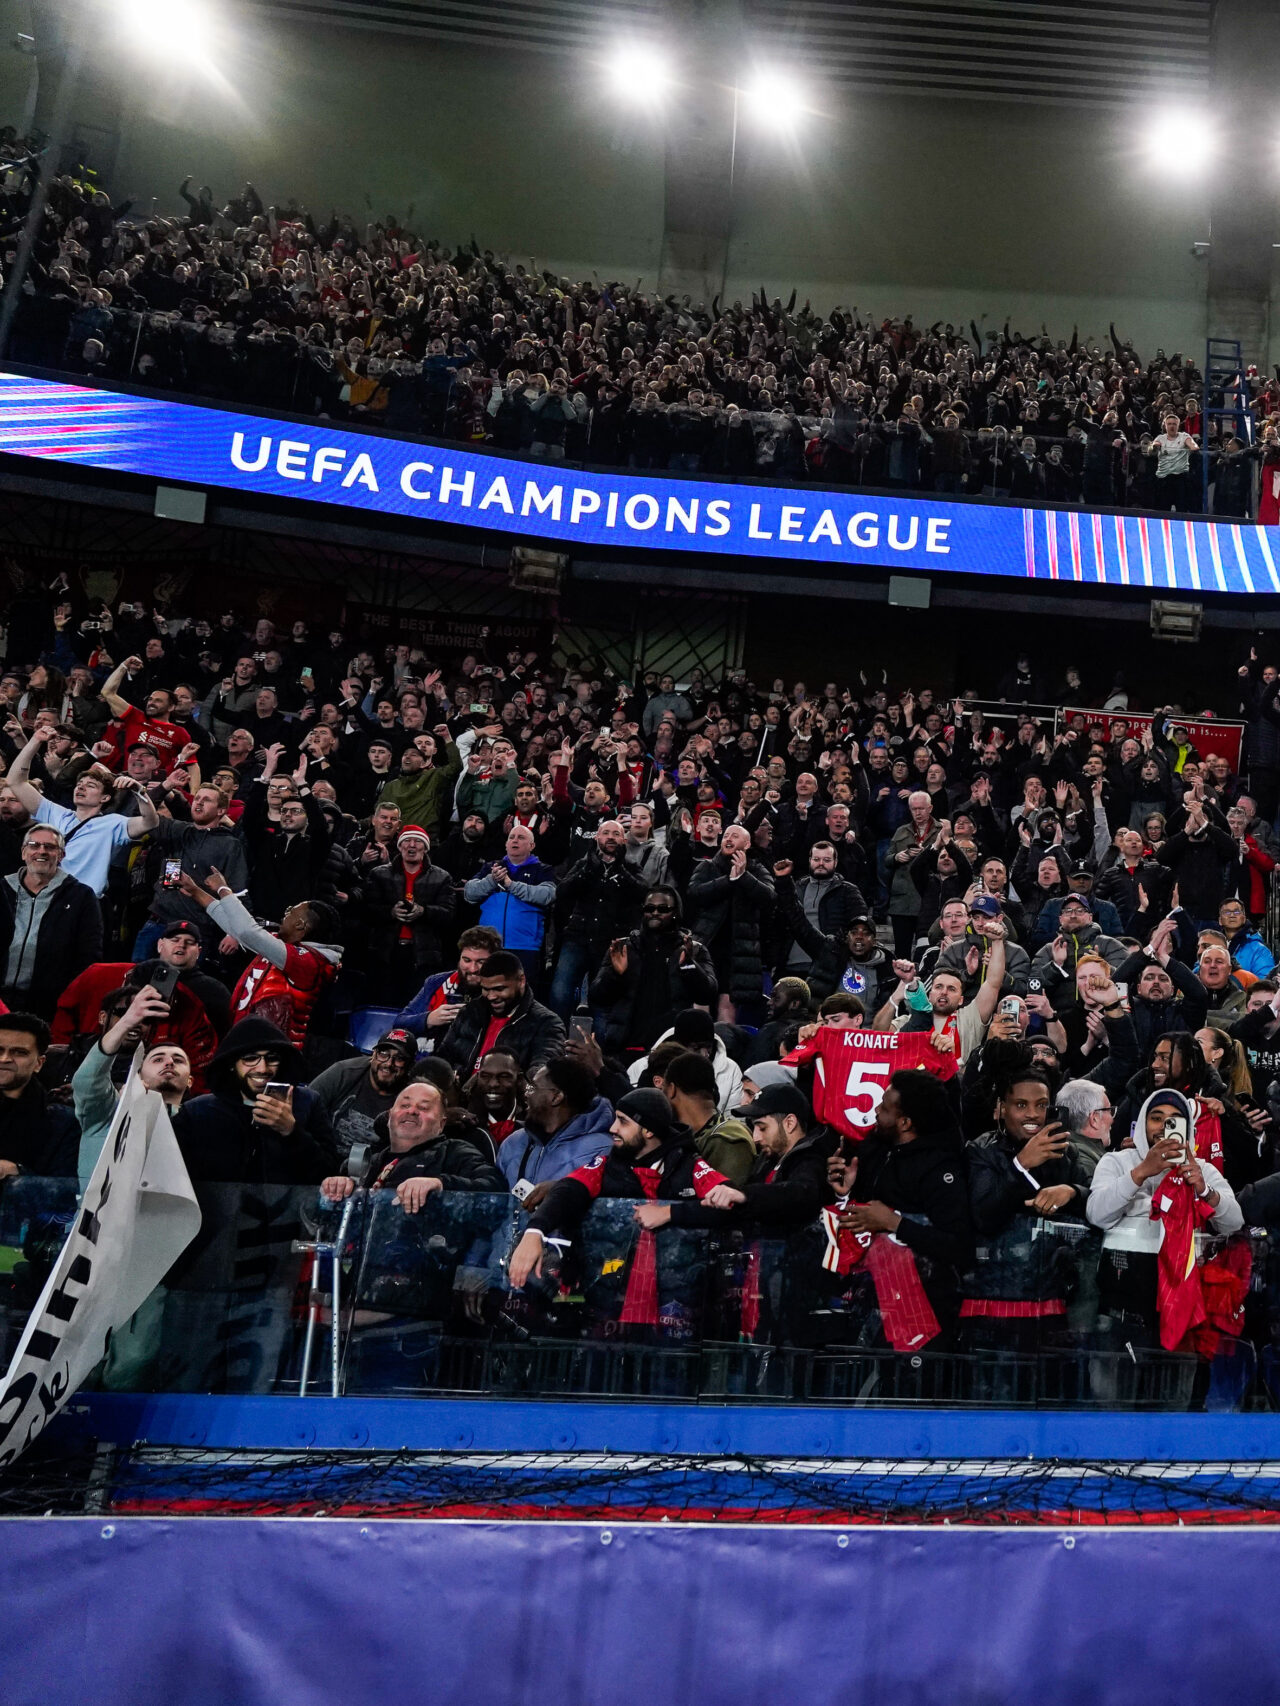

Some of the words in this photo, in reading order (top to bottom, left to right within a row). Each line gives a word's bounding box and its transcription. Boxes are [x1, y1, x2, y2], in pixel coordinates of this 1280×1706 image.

[230, 431, 380, 492] UEFA
[400, 461, 731, 537] CHAMPIONS
[748, 503, 952, 554] LEAGUE
[361, 611, 392, 627] THE
[399, 617, 436, 632] BEST
[843, 1030, 899, 1049] KONATÉ
[844, 1061, 890, 1127] 5
